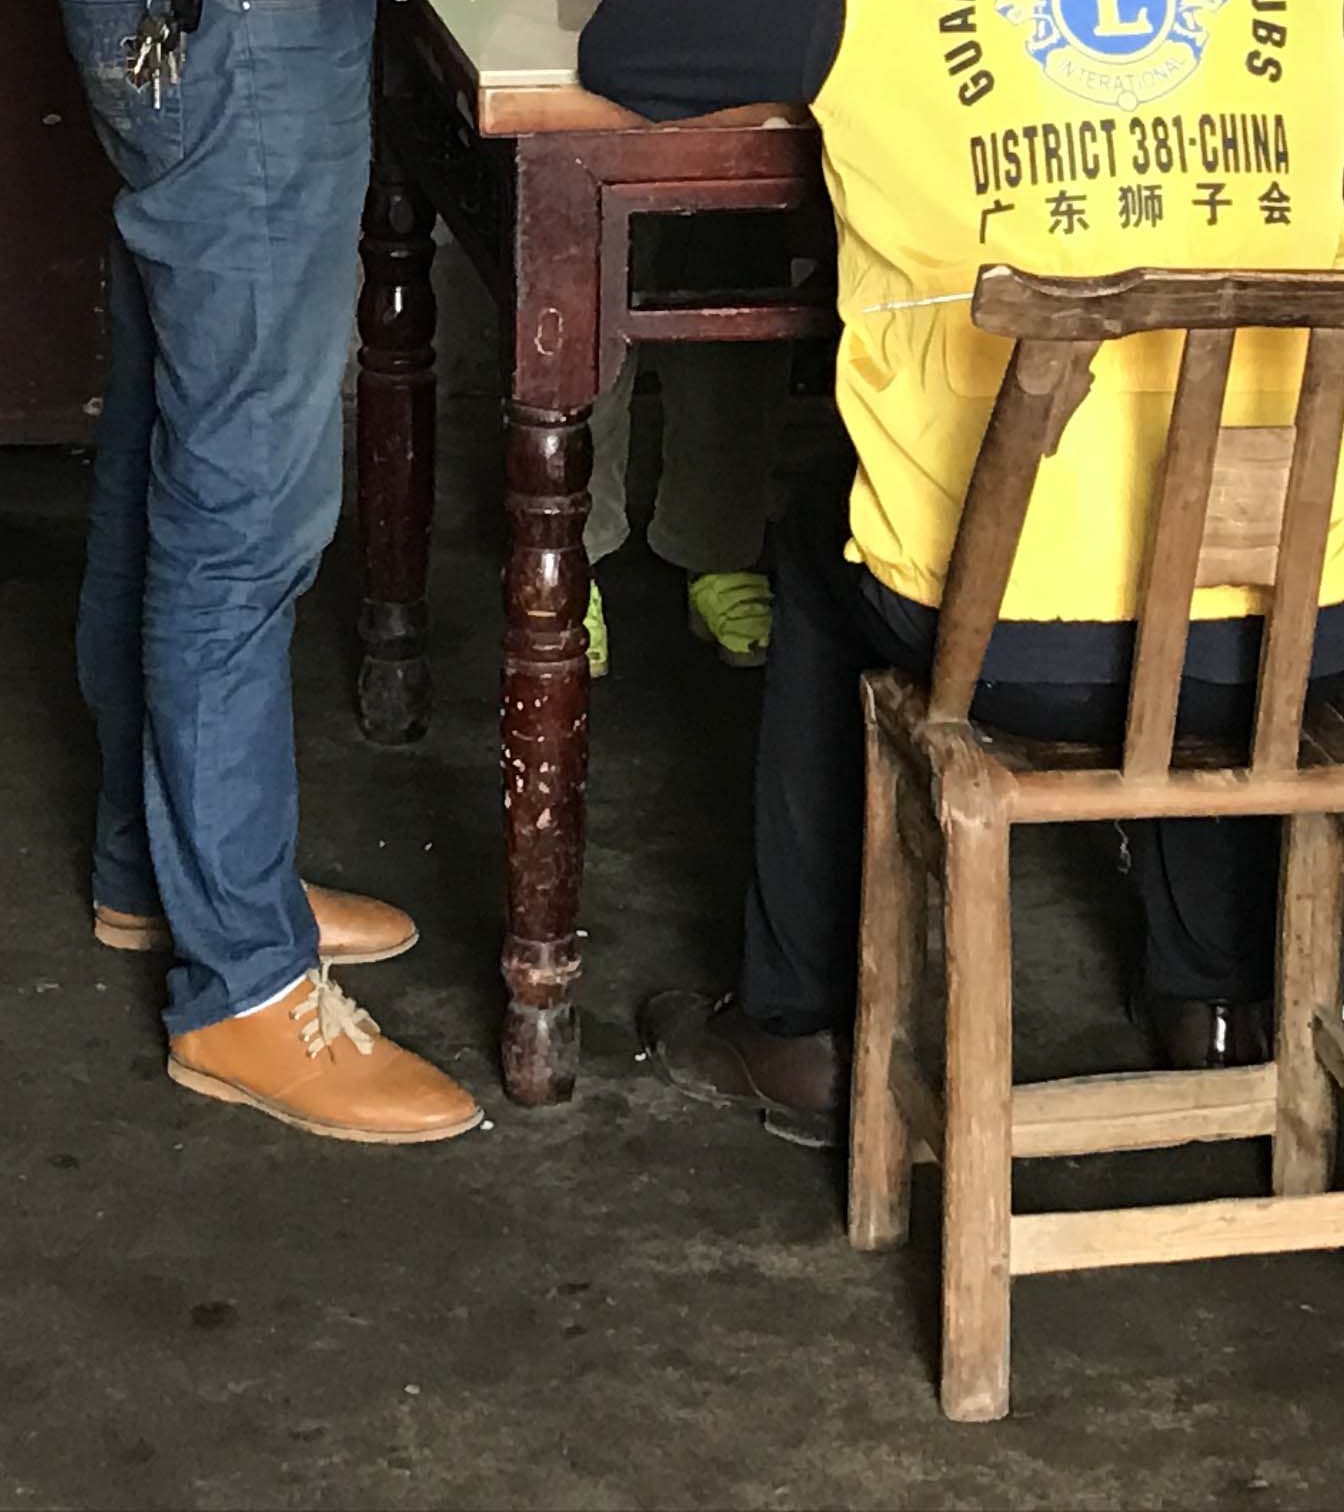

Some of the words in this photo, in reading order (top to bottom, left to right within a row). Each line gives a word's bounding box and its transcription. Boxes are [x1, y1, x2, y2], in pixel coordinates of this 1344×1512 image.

[970, 119, 1117, 195] DISTRICT
[1130, 114, 1290, 175] 381-CHINA
[979, 180, 1292, 245] 广东狮子会
